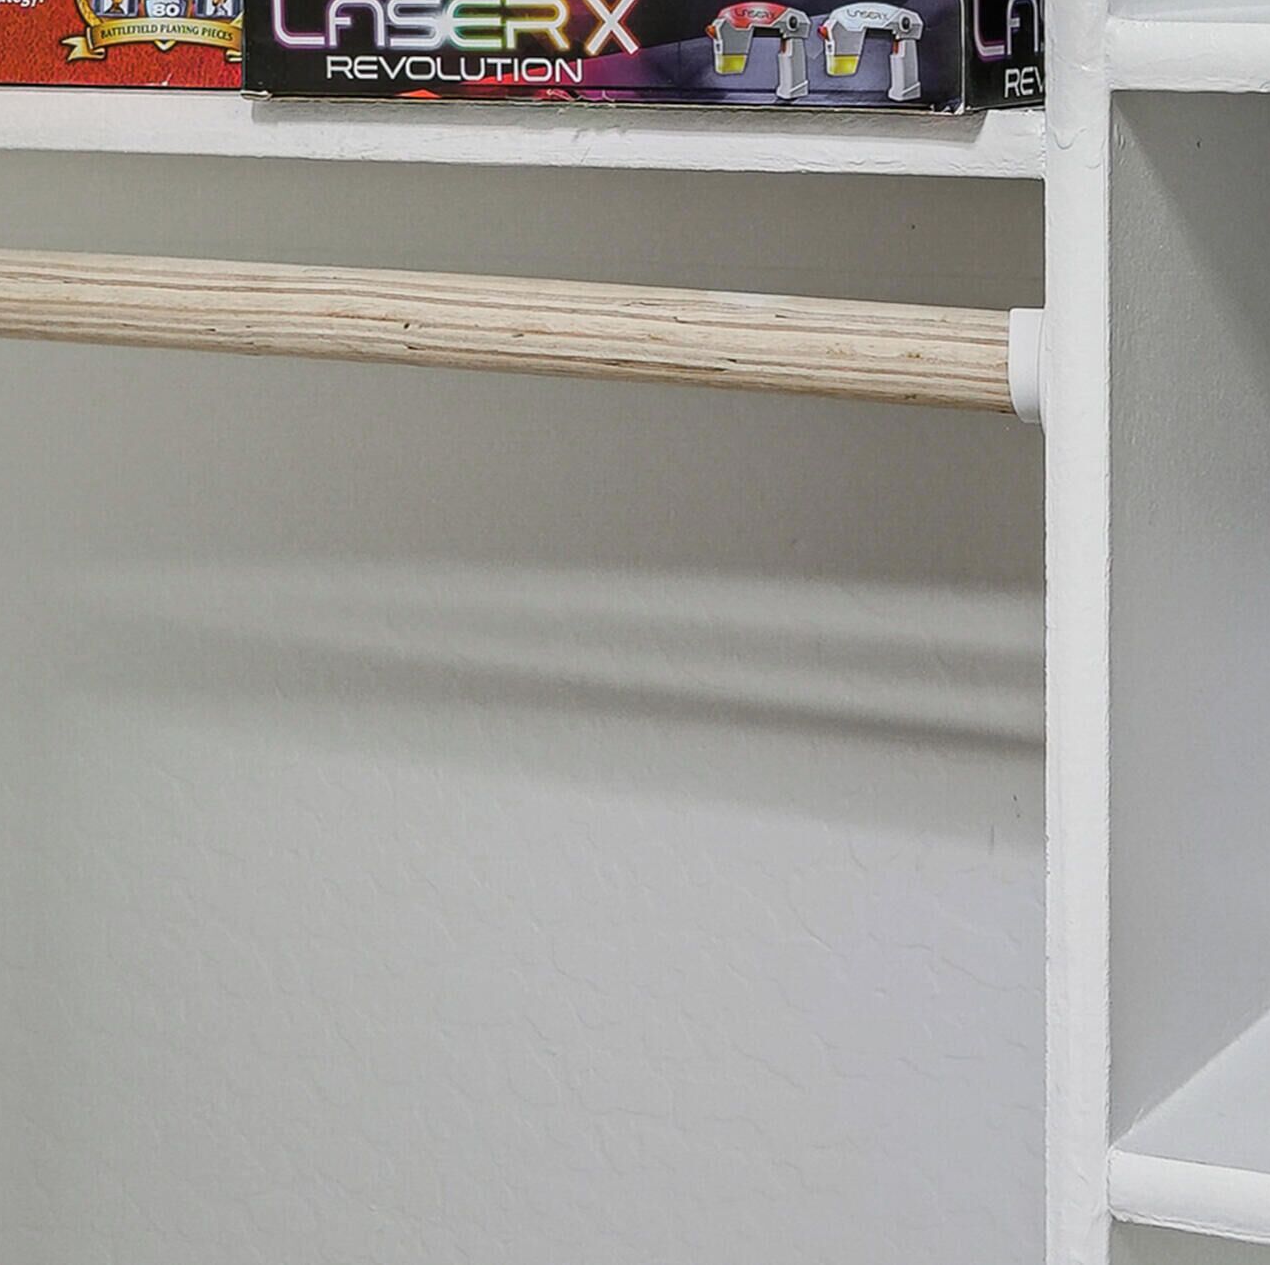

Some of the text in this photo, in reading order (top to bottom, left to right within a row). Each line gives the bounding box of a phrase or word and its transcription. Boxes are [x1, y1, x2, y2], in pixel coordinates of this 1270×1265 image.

[153, 2, 180, 17] 80
[101, 23, 233, 41] BATTLEFIELD PLAYING PIECES
[325, 54, 584, 83] REVOLUTION
